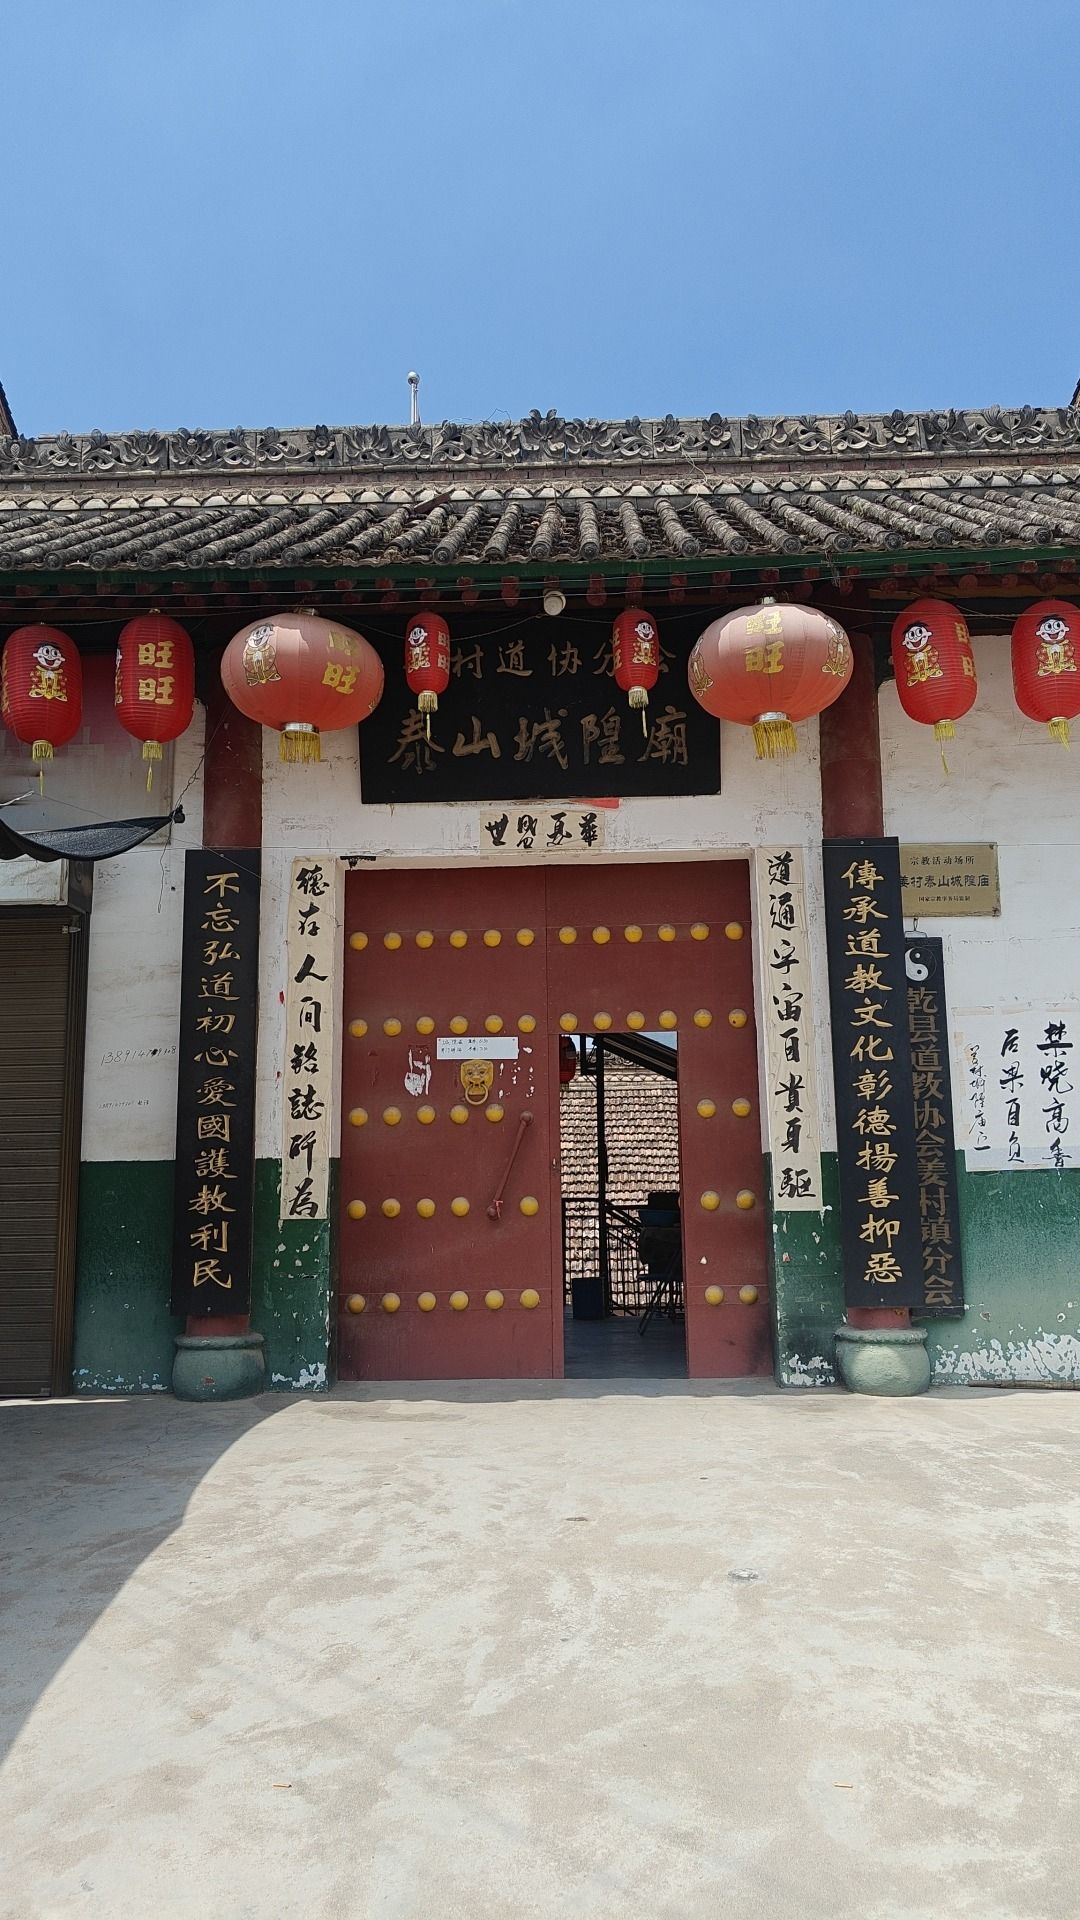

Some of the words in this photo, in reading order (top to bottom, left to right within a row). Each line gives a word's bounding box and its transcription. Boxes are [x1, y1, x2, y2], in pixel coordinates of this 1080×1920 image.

[137, 640, 175, 705] 旺旺
[744, 610, 784, 674] 旺旺
[910, 855, 976, 866] 宗教活动场所
[188, 872, 241, 1289] 不忘弘道初心愛國護教利民
